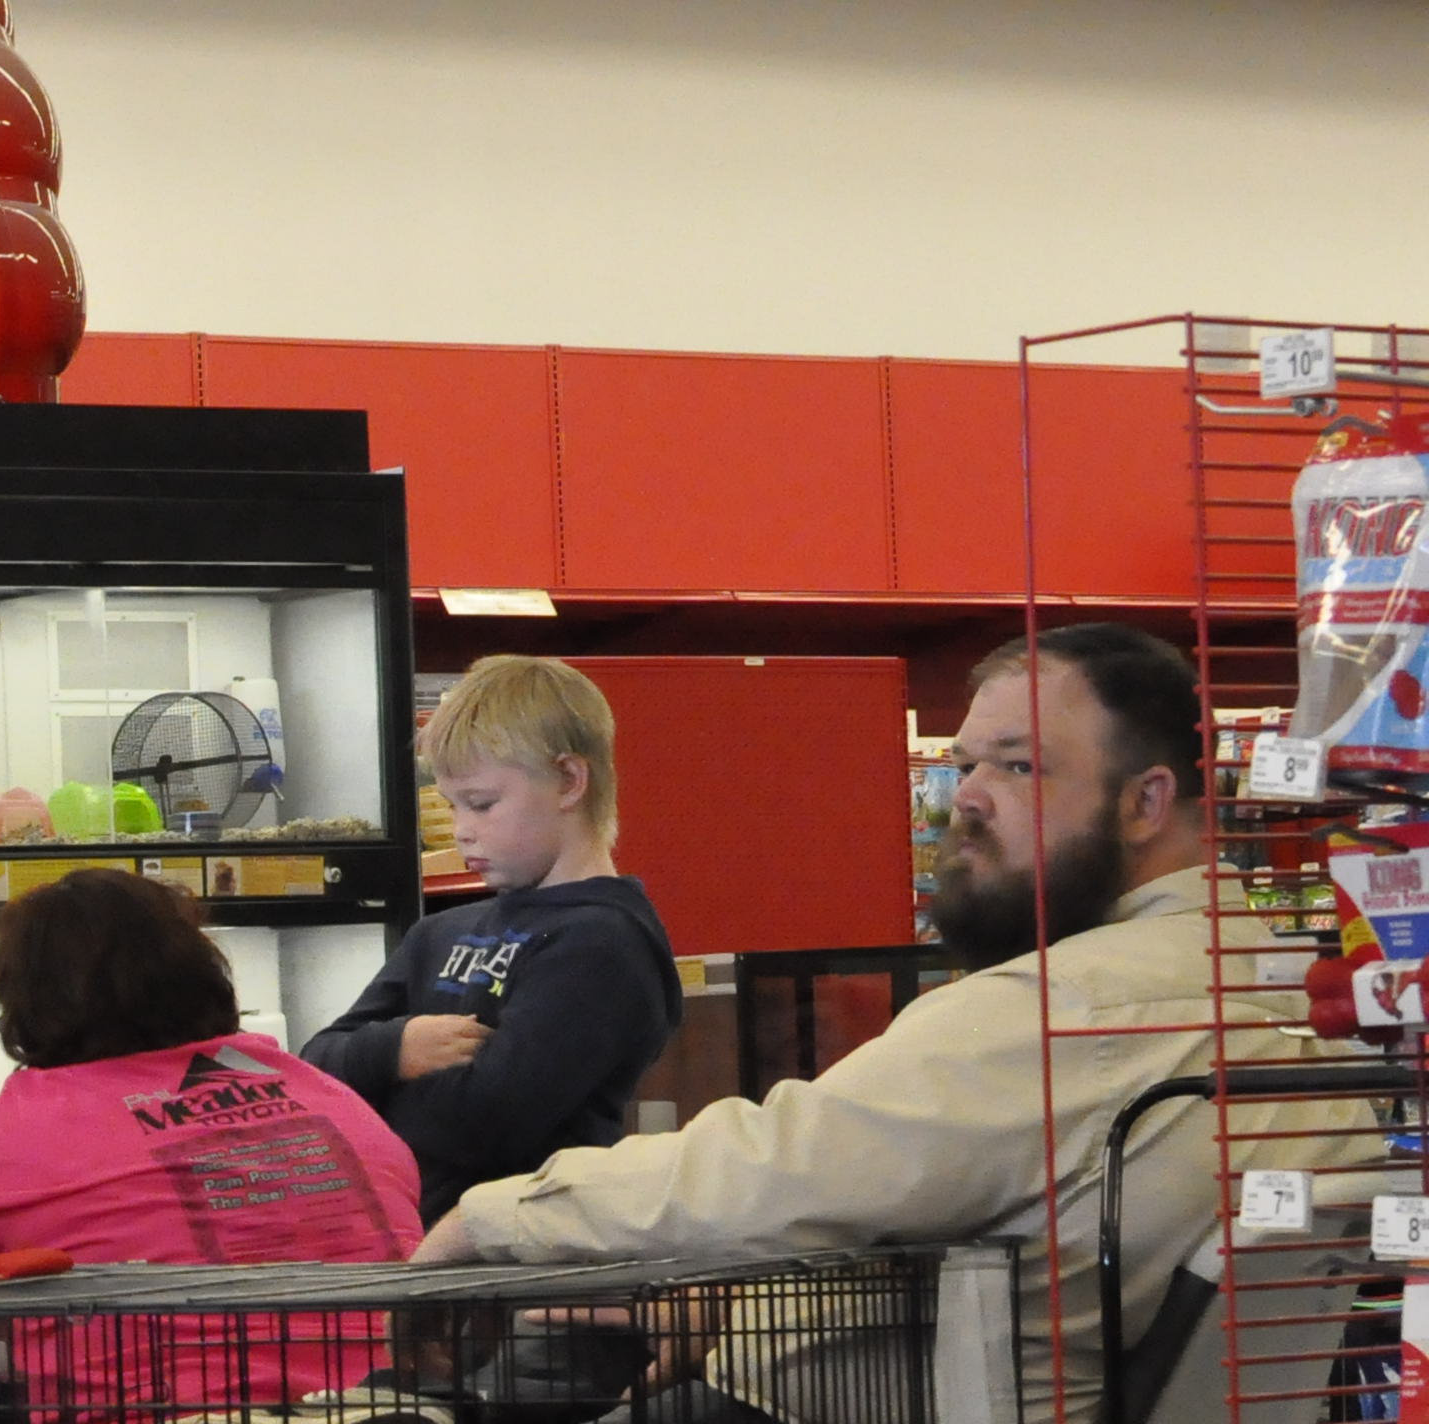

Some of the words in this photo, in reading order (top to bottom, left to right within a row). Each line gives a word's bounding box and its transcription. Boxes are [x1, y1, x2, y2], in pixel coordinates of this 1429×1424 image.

[1305, 494, 1424, 557] KONG
[133, 1078, 288, 1136] Meador
[196, 1099, 308, 1128] TOYOTA
